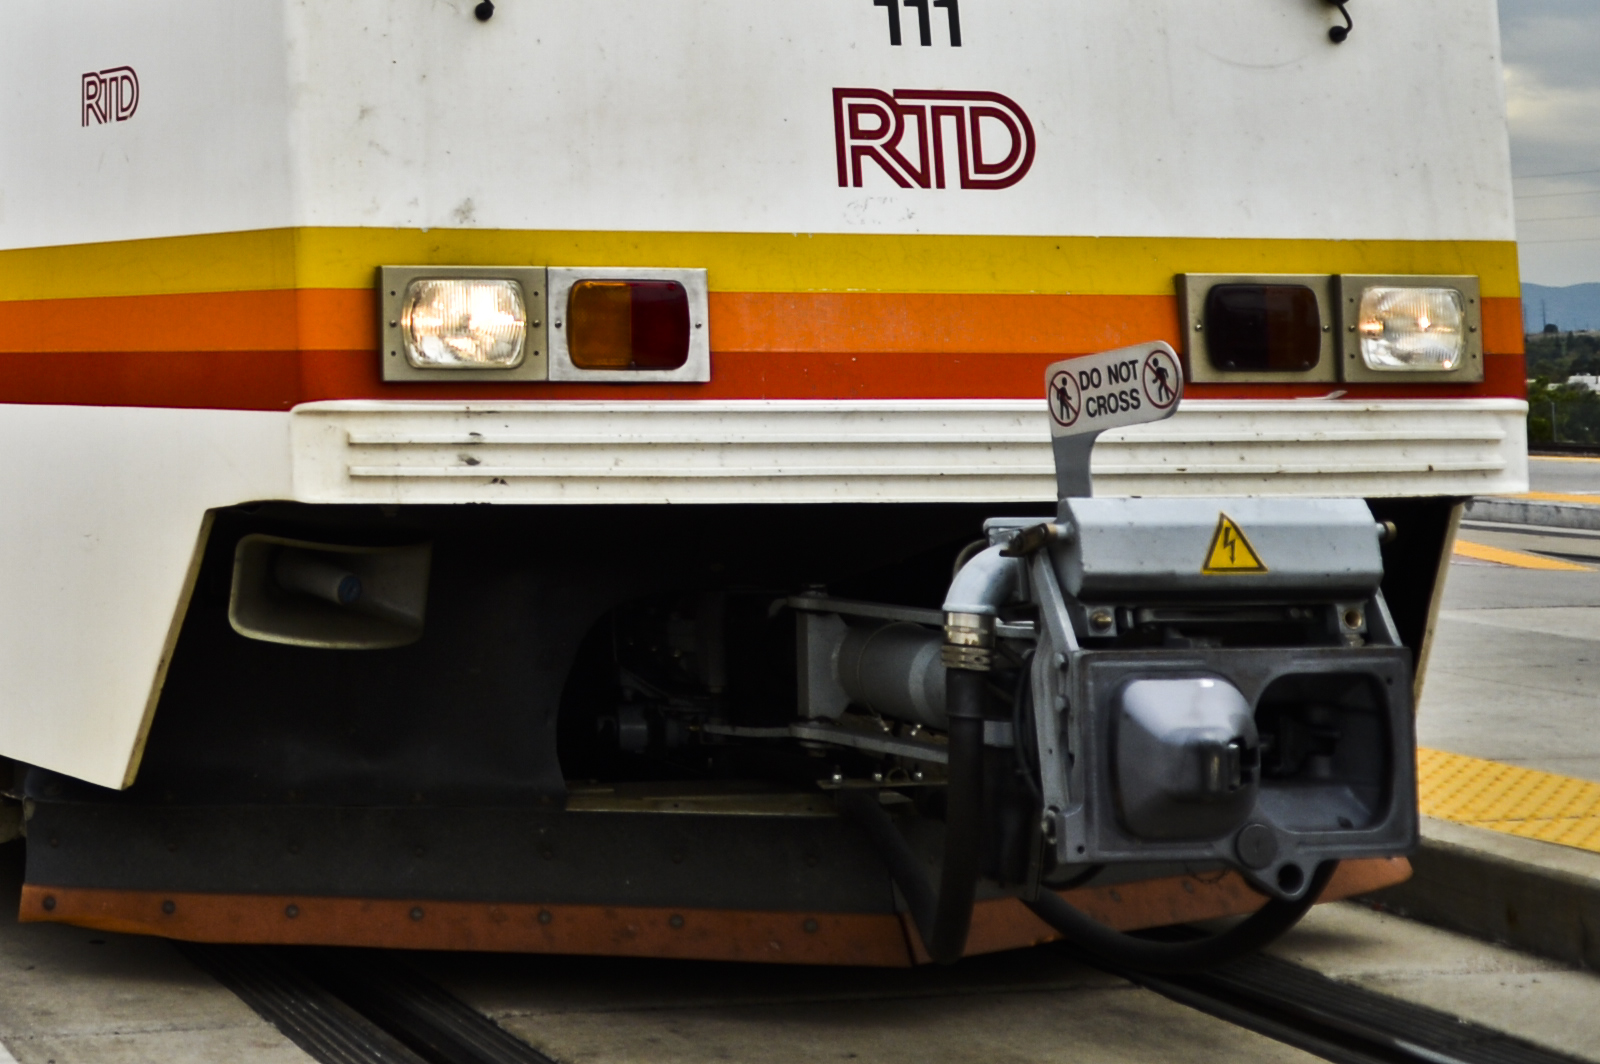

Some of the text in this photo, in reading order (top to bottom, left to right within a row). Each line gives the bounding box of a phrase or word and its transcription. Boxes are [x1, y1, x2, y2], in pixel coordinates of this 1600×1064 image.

[82, 65, 139, 127] RTD
[832, 87, 1036, 190] RTD
[1079, 359, 1139, 391] DO NOT
[1086, 388, 1141, 417] CROSS
